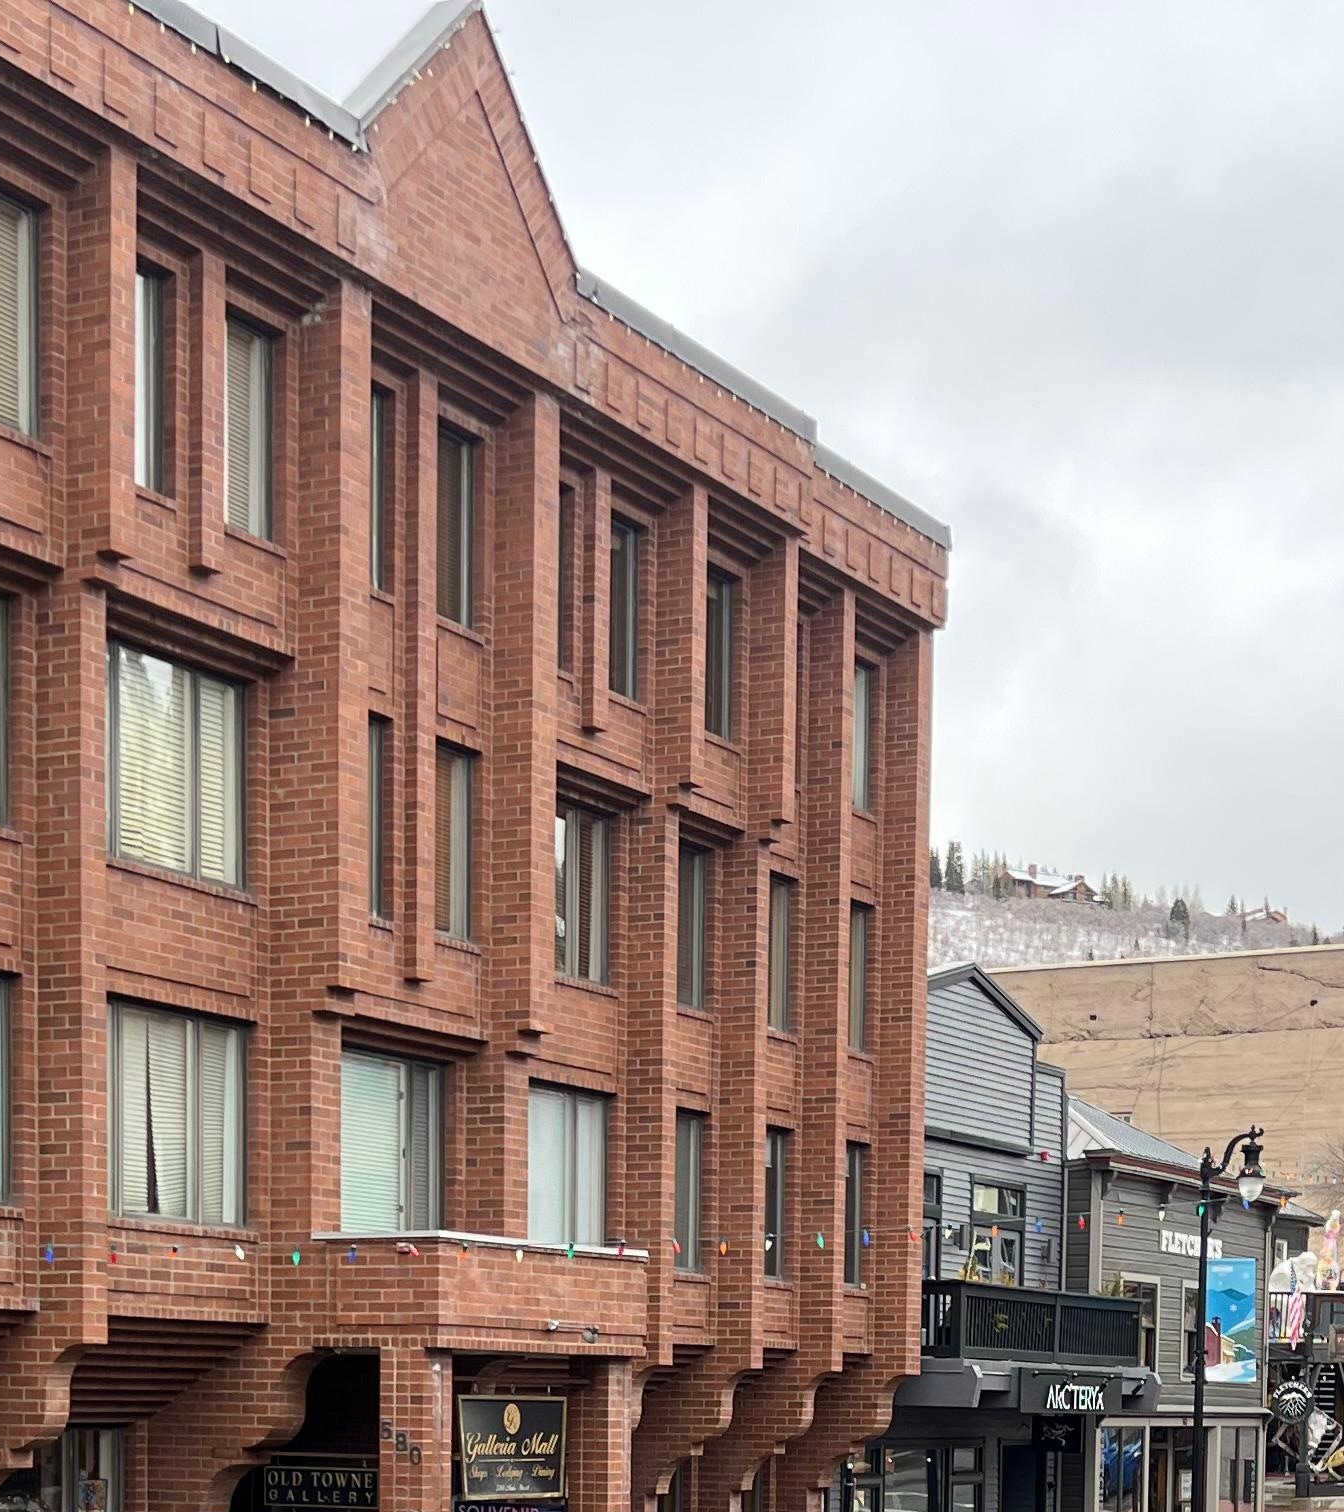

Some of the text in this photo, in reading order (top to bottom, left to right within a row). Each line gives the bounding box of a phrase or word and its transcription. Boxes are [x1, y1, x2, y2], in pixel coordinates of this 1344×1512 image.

[1161, 1230, 1223, 1259] FLETCHR'S
[381, 1419, 422, 1466] 580
[465, 1432, 559, 1463] Galleria Mall
[267, 1470, 374, 1489] OLD TOWNE
[268, 1489, 374, 1504] GALLERY
